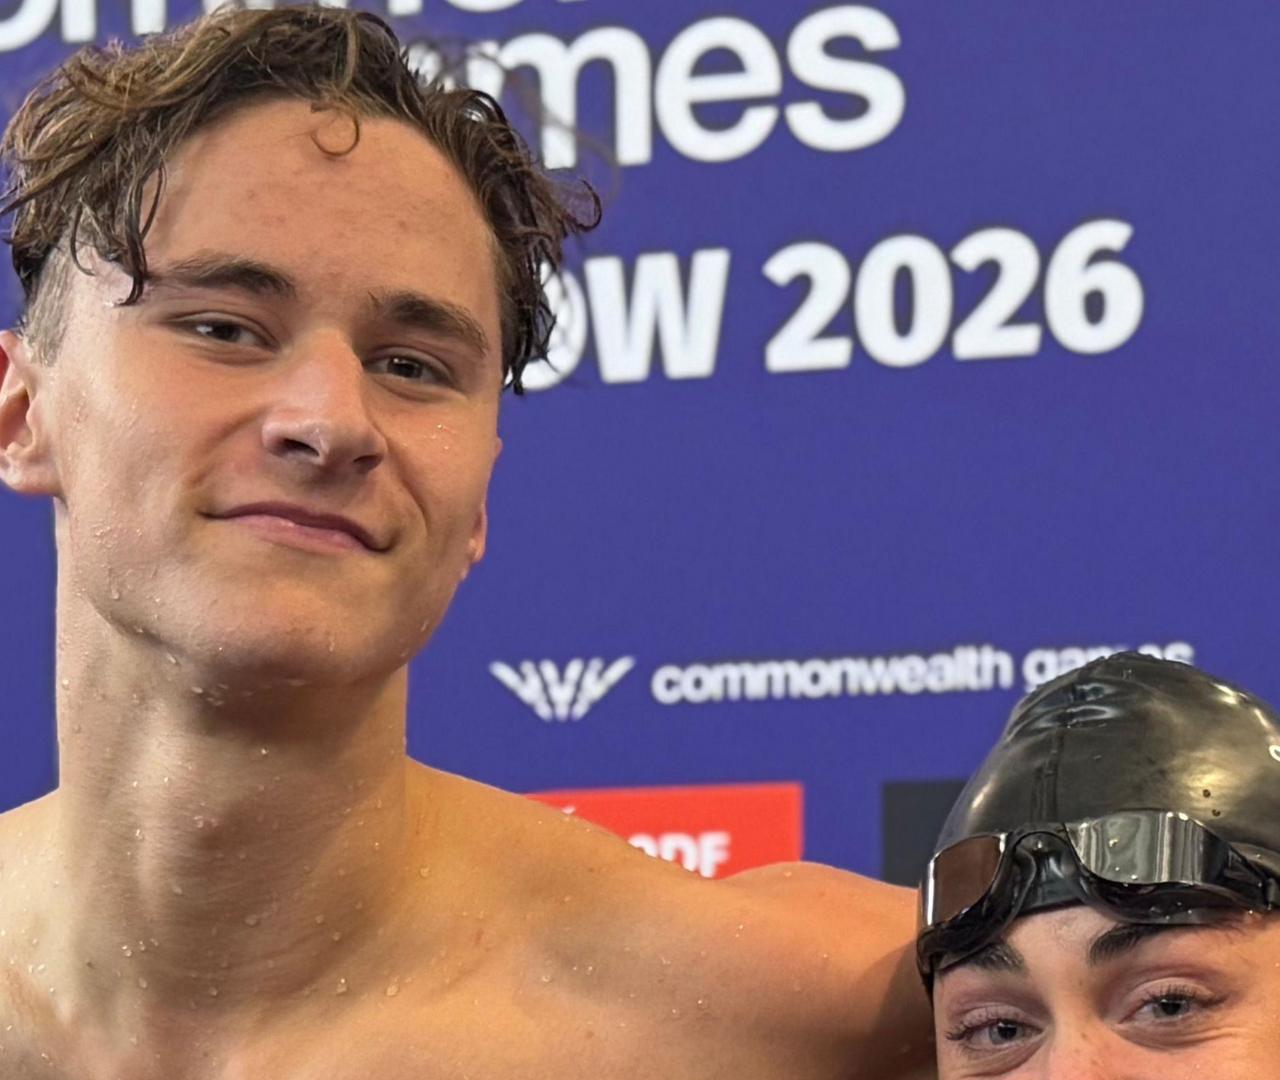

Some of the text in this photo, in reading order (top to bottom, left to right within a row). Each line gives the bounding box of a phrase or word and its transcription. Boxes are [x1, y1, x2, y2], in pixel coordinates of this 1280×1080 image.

[412, 5, 907, 171] mes
[762, 219, 1144, 373] 2026
[651, 644, 1014, 705] commonwealth
